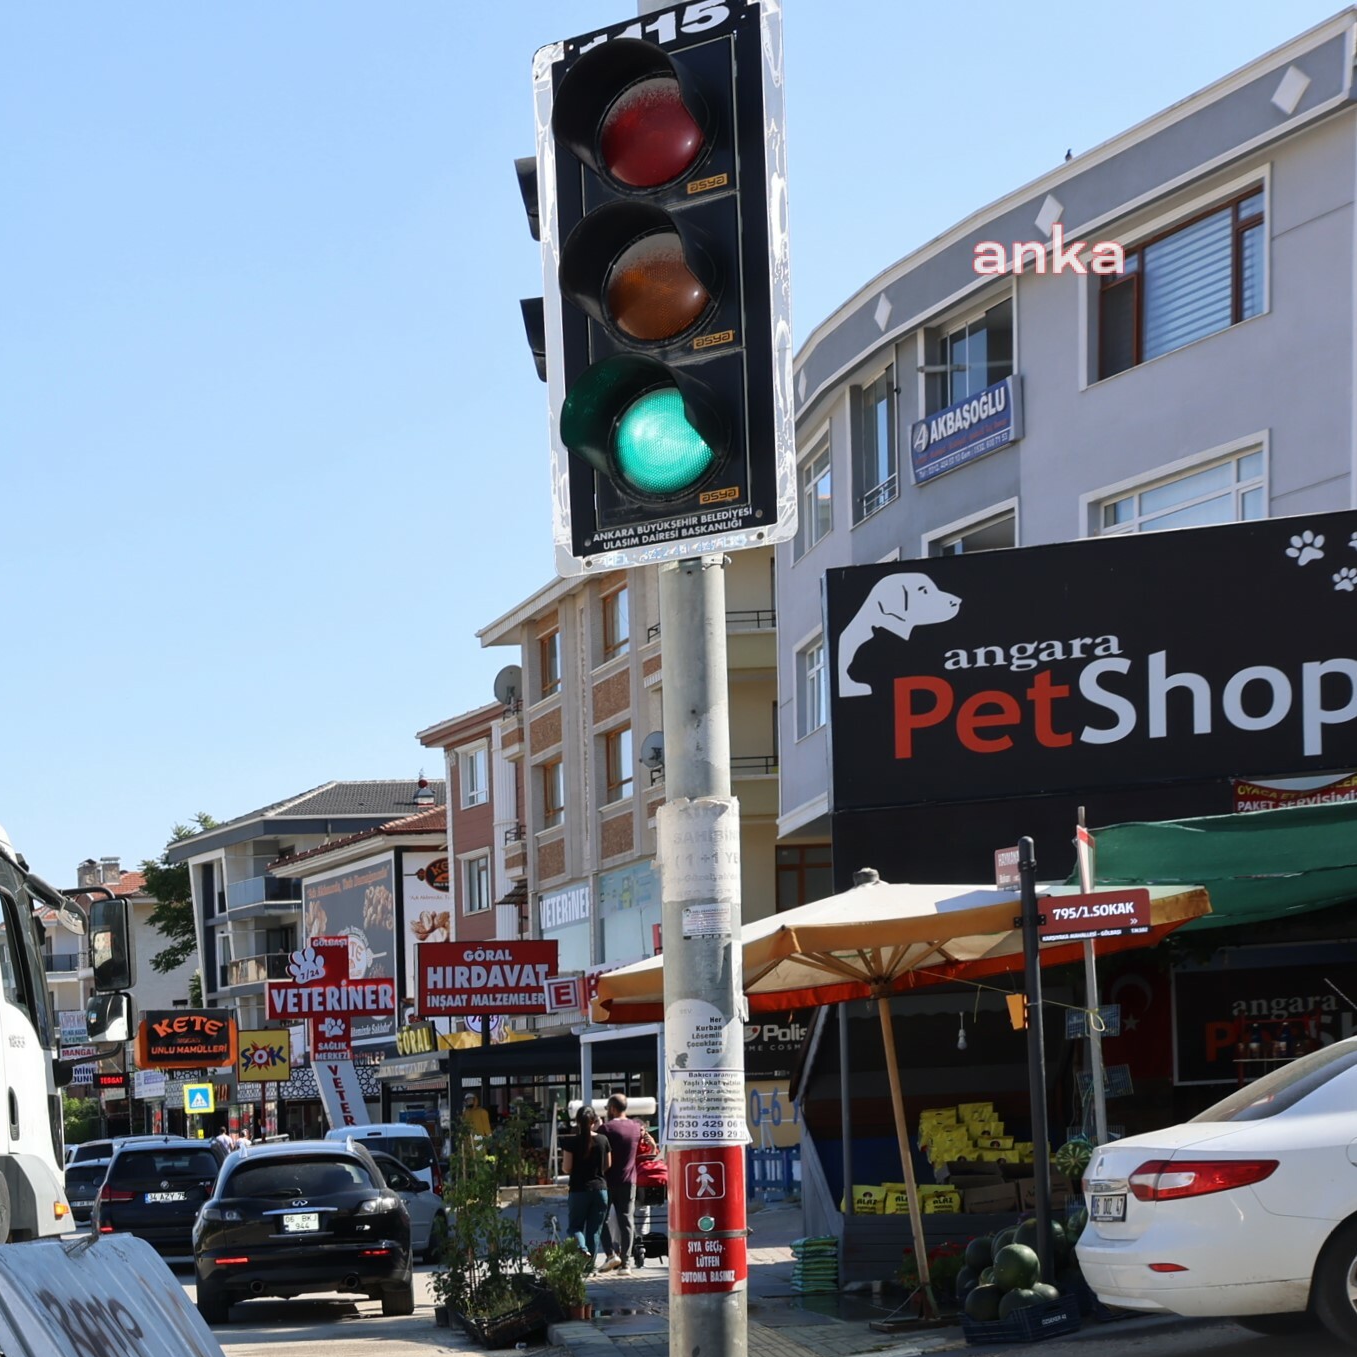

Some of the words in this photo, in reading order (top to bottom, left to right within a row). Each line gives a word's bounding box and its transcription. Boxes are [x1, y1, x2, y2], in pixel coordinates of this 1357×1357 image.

[930, 386, 1006, 444] AKBAŞOĞLU
[593, 528, 634, 543] ANKARA
[700, 506, 753, 524] BELEDİYESİ
[642, 528, 679, 544] DAİRESİ
[944, 635, 1123, 671] angara
[894, 650, 1357, 759] PetShop
[1238, 801, 1276, 811] PAKET
[1278, 789, 1357, 809] SERVİSİMİ
[1052, 902, 1134, 920] 795/1.SOKAK
[463, 946, 513, 962] GÖRAL
[427, 963, 549, 989] HIRDAVAT
[271, 979, 394, 1013] VETERİNER
[427, 993, 467, 1011] İNŞAAT
[471, 993, 545, 1007] MALZEMELER
[153, 1016, 223, 1038] KETE
[151, 1046, 175, 1055] UNLU
[318, 1041, 347, 1051] SAĞLIK
[397, 1024, 432, 1057] GÖRAL
[315, 1050, 350, 1060] MERKEZİ
[696, 1255, 720, 1268] LÜTFEN
